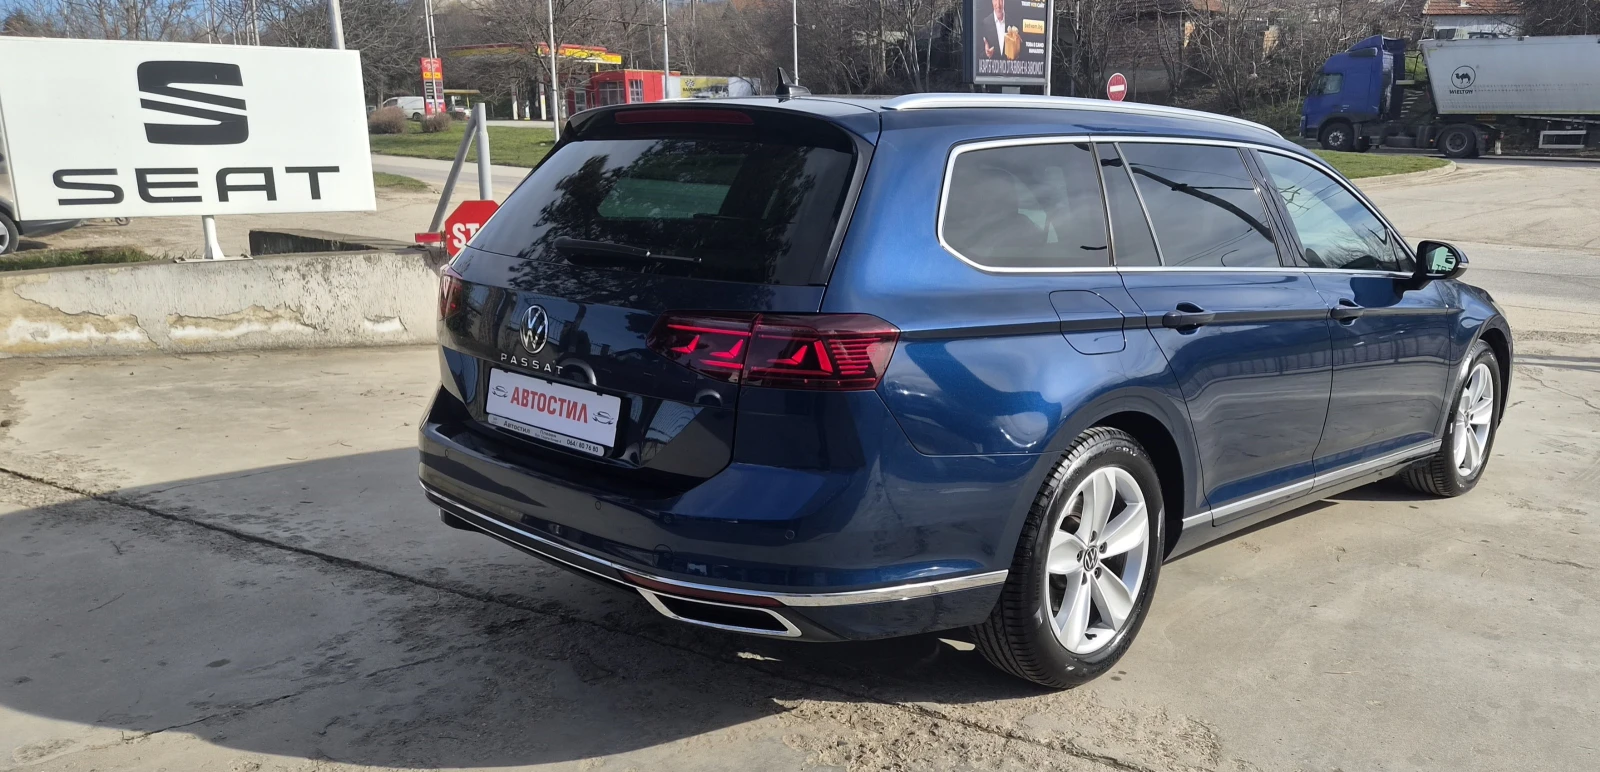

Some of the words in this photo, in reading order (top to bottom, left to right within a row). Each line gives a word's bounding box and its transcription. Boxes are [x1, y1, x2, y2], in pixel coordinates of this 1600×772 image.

[53, 166, 340, 205] SEAT
[452, 222, 480, 249] ST
[500, 352, 563, 375] PASSAT
[510, 386, 588, 424] АВТОСТИЛ
[503, 420, 531, 435] Автостил
